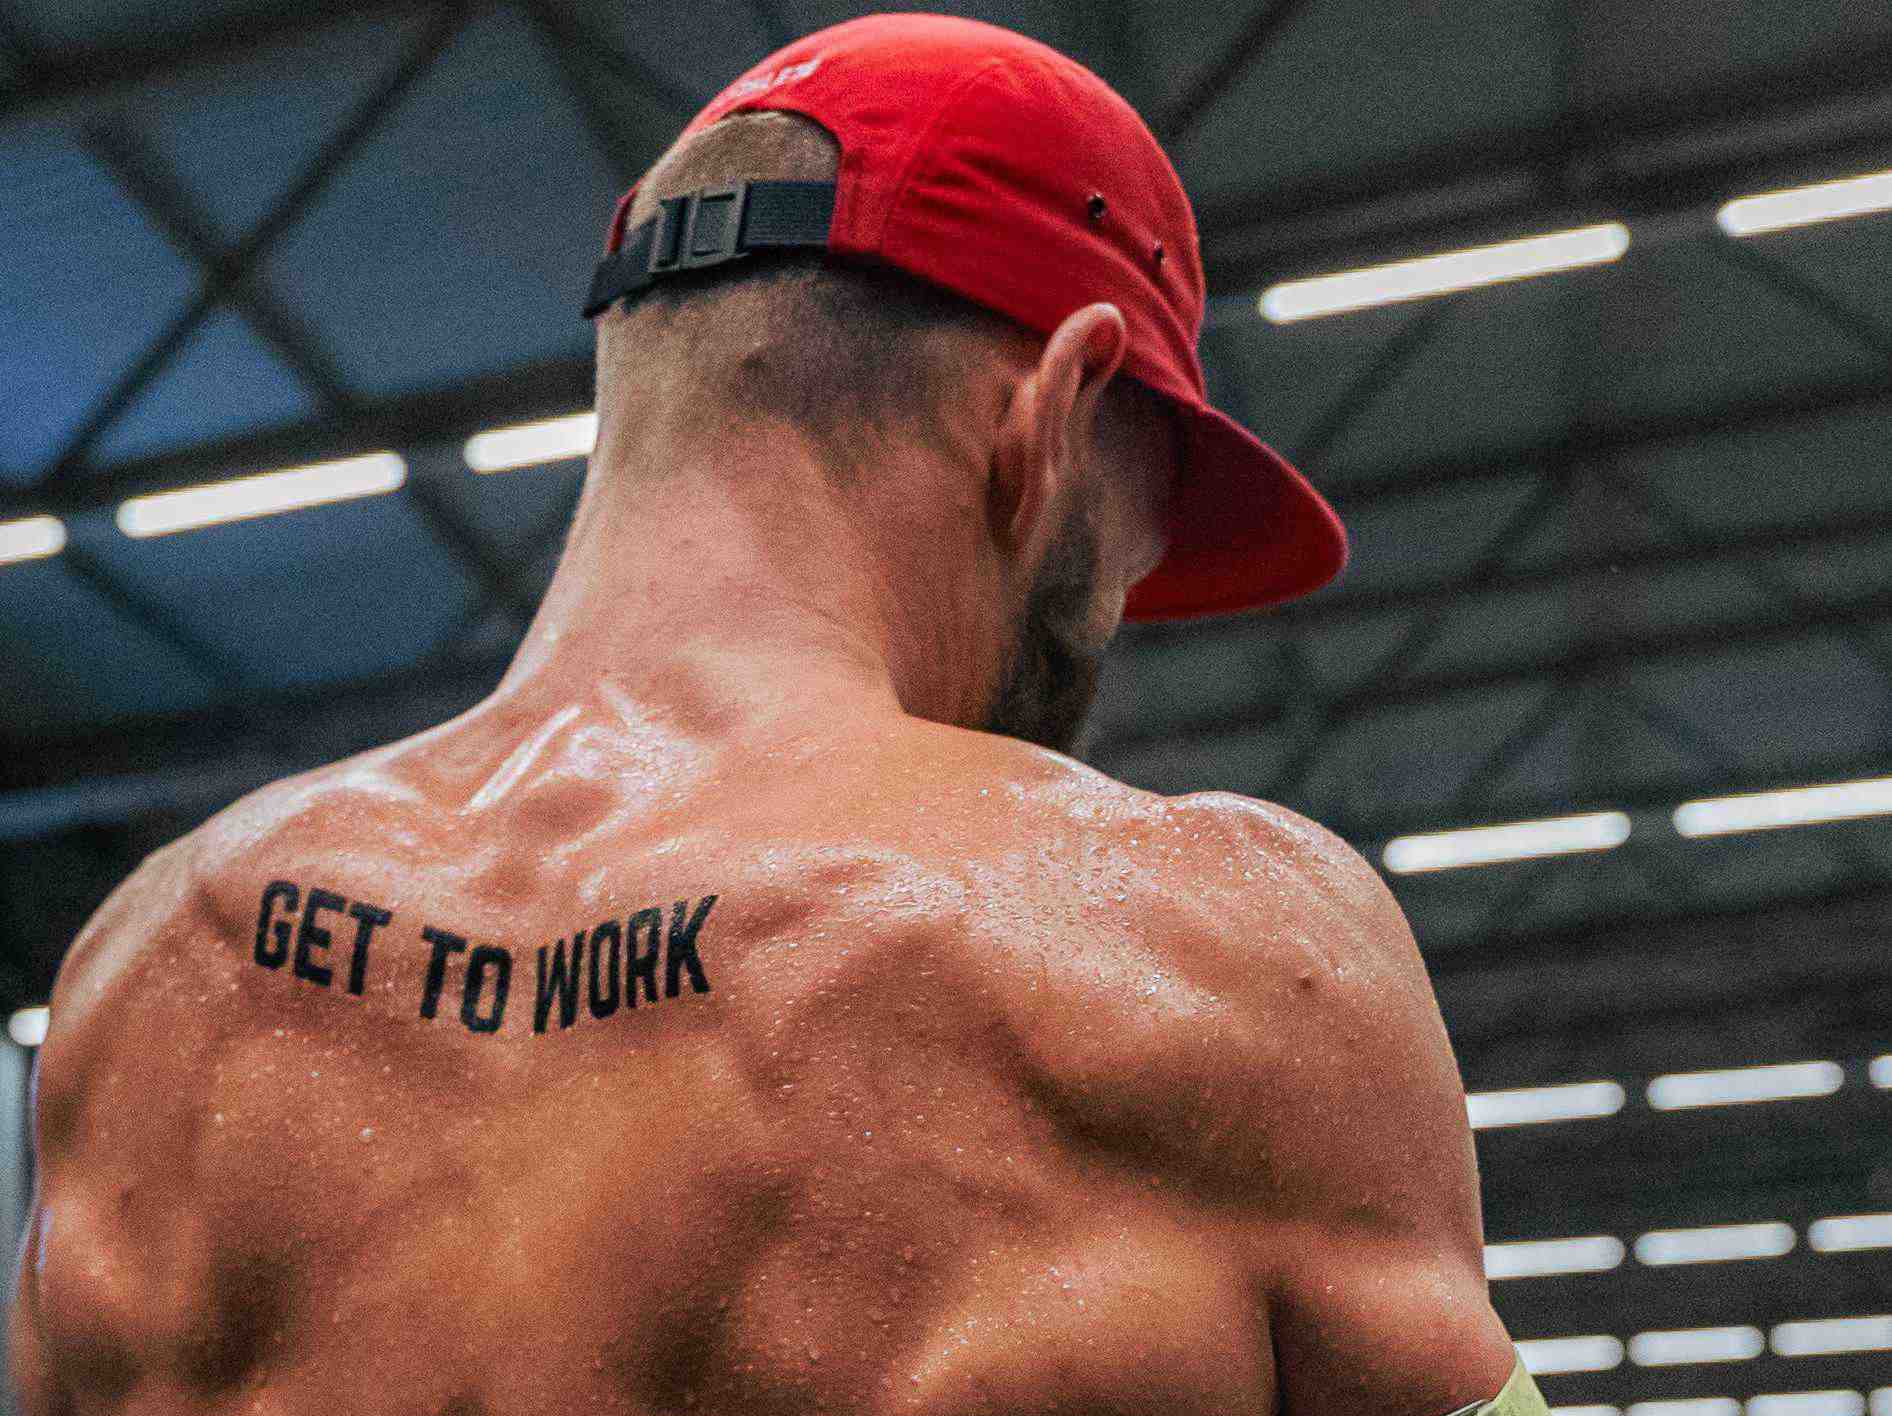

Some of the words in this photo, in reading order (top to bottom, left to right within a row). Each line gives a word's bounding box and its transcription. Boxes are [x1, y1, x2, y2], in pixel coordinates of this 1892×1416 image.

[253, 880, 393, 996] GET
[418, 925, 513, 1035] TO
[533, 893, 720, 1035] WORK
